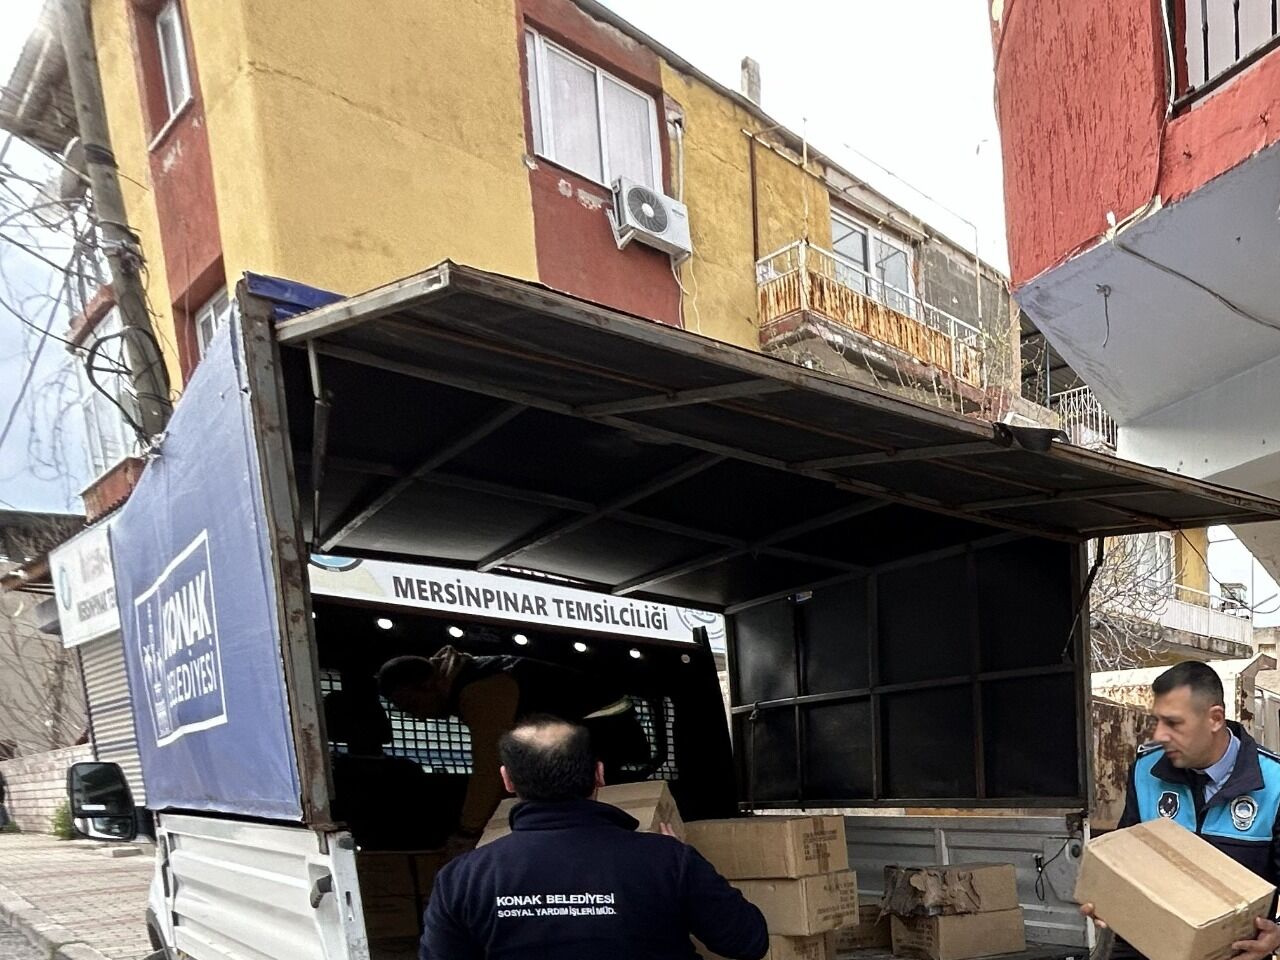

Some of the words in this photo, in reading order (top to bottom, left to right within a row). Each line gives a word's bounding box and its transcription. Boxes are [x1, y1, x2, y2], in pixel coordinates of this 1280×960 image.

[162, 570, 212, 660] KONAK
[393, 576, 548, 617] MERSİNPINAR
[552, 597, 669, 631] TEMSİLCİLİĞİ
[496, 894, 542, 906] KONAK
[546, 892, 615, 904] BELEDİYESİ
[498, 908, 534, 917] SOSYAL
